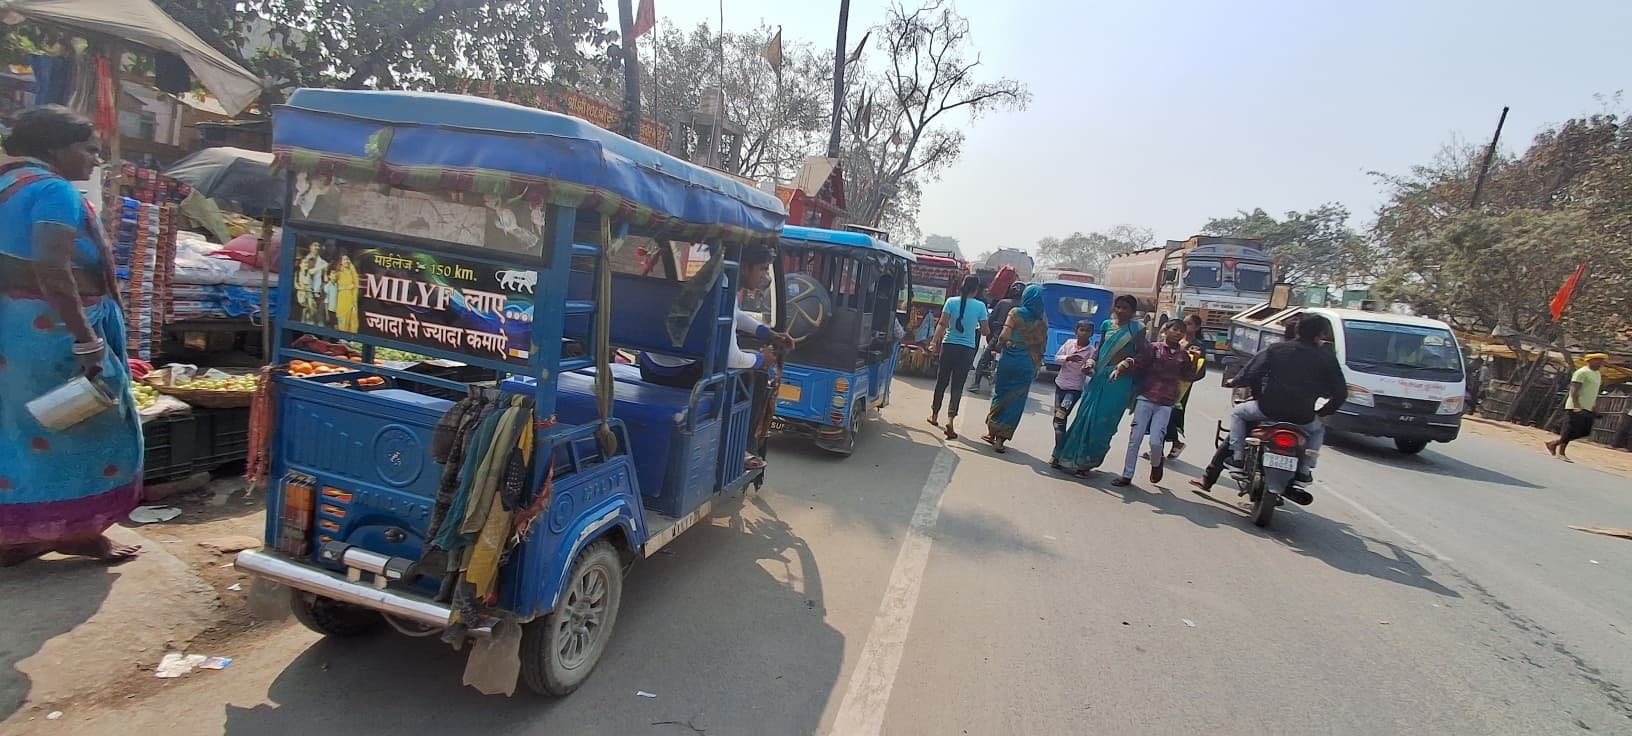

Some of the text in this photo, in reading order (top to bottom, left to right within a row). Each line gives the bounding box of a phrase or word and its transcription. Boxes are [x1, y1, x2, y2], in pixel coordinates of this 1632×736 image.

[373, 253, 412, 272] माईलेज
[431, 263, 451, 277] 150
[455, 264, 477, 282] km.
[364, 273, 454, 311] MILYF
[364, 311, 403, 338] ज्यादा
[406, 313, 419, 339] से
[421, 320, 463, 349] ज्यादा
